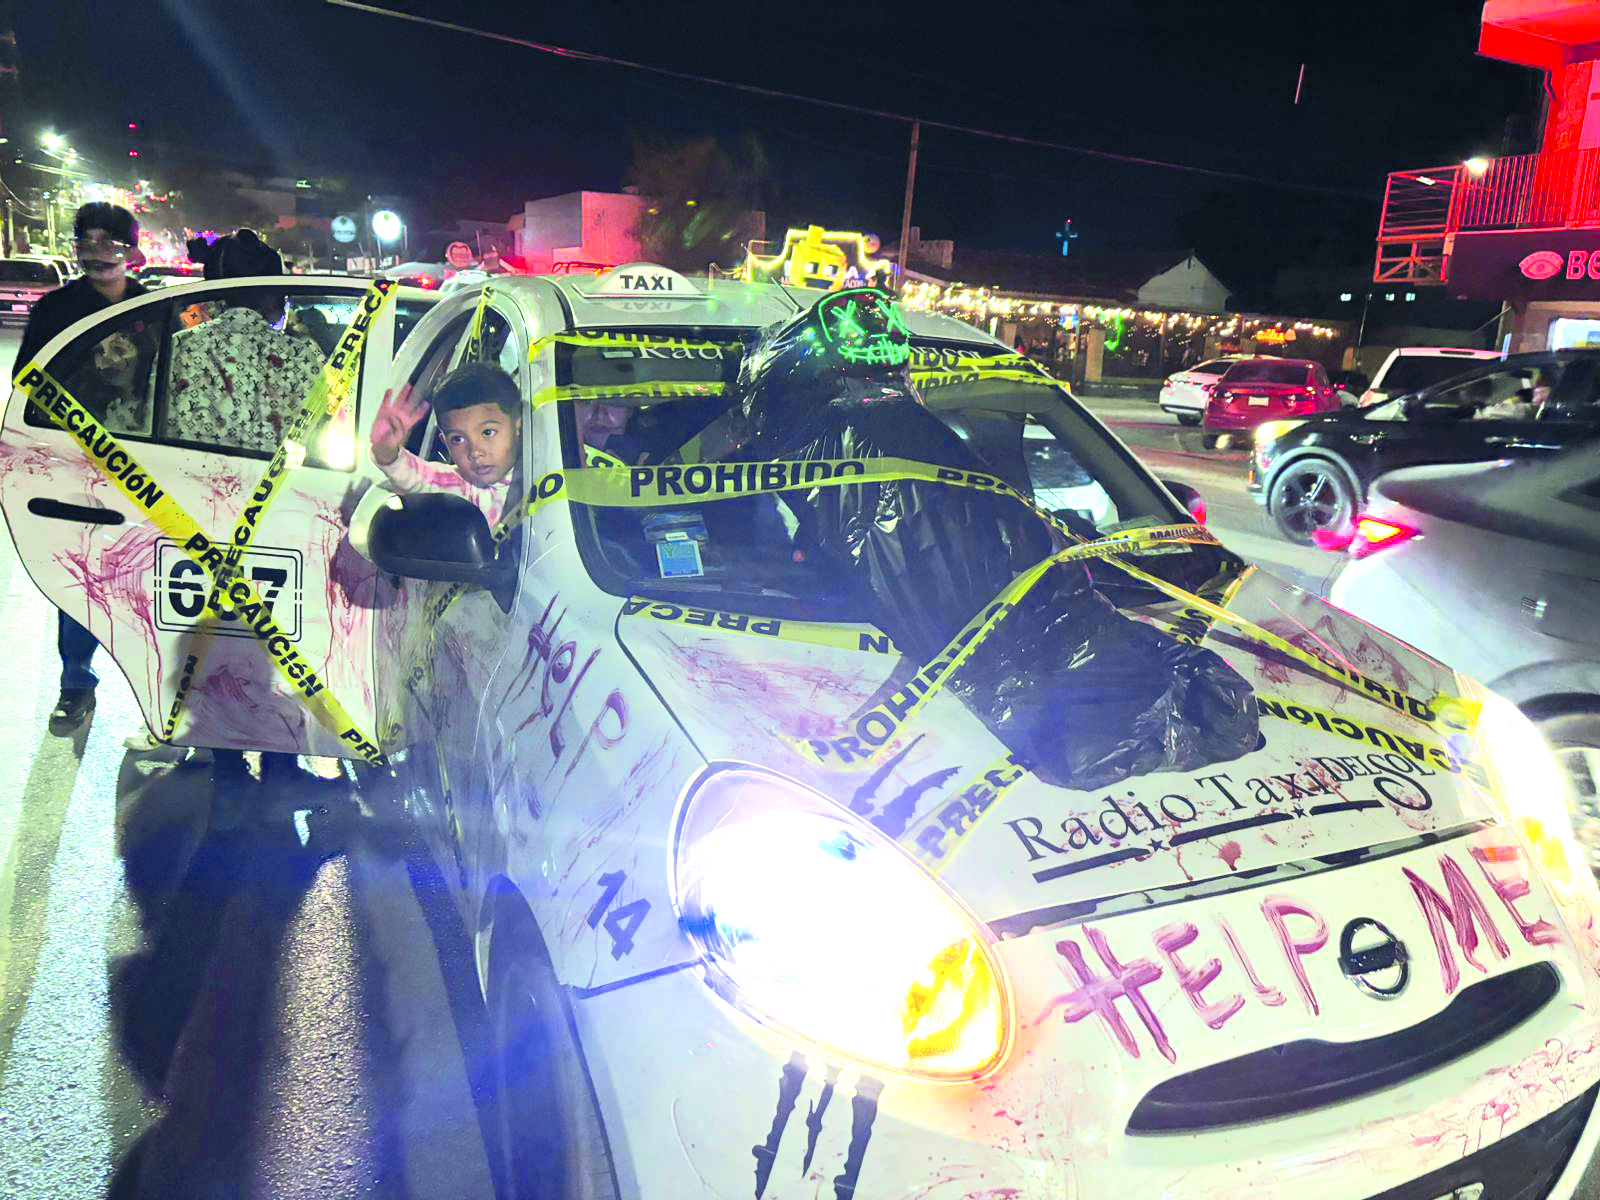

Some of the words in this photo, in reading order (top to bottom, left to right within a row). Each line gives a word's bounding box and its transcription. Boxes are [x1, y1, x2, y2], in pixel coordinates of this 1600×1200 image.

[619, 274, 673, 291] TAXI
[630, 457, 866, 499] PROHIBIDO
[1002, 790, 1198, 862] Radio
[1193, 762, 1335, 812] Taxi
[586, 868, 652, 961] 14
[1401, 846, 1563, 996] ME
